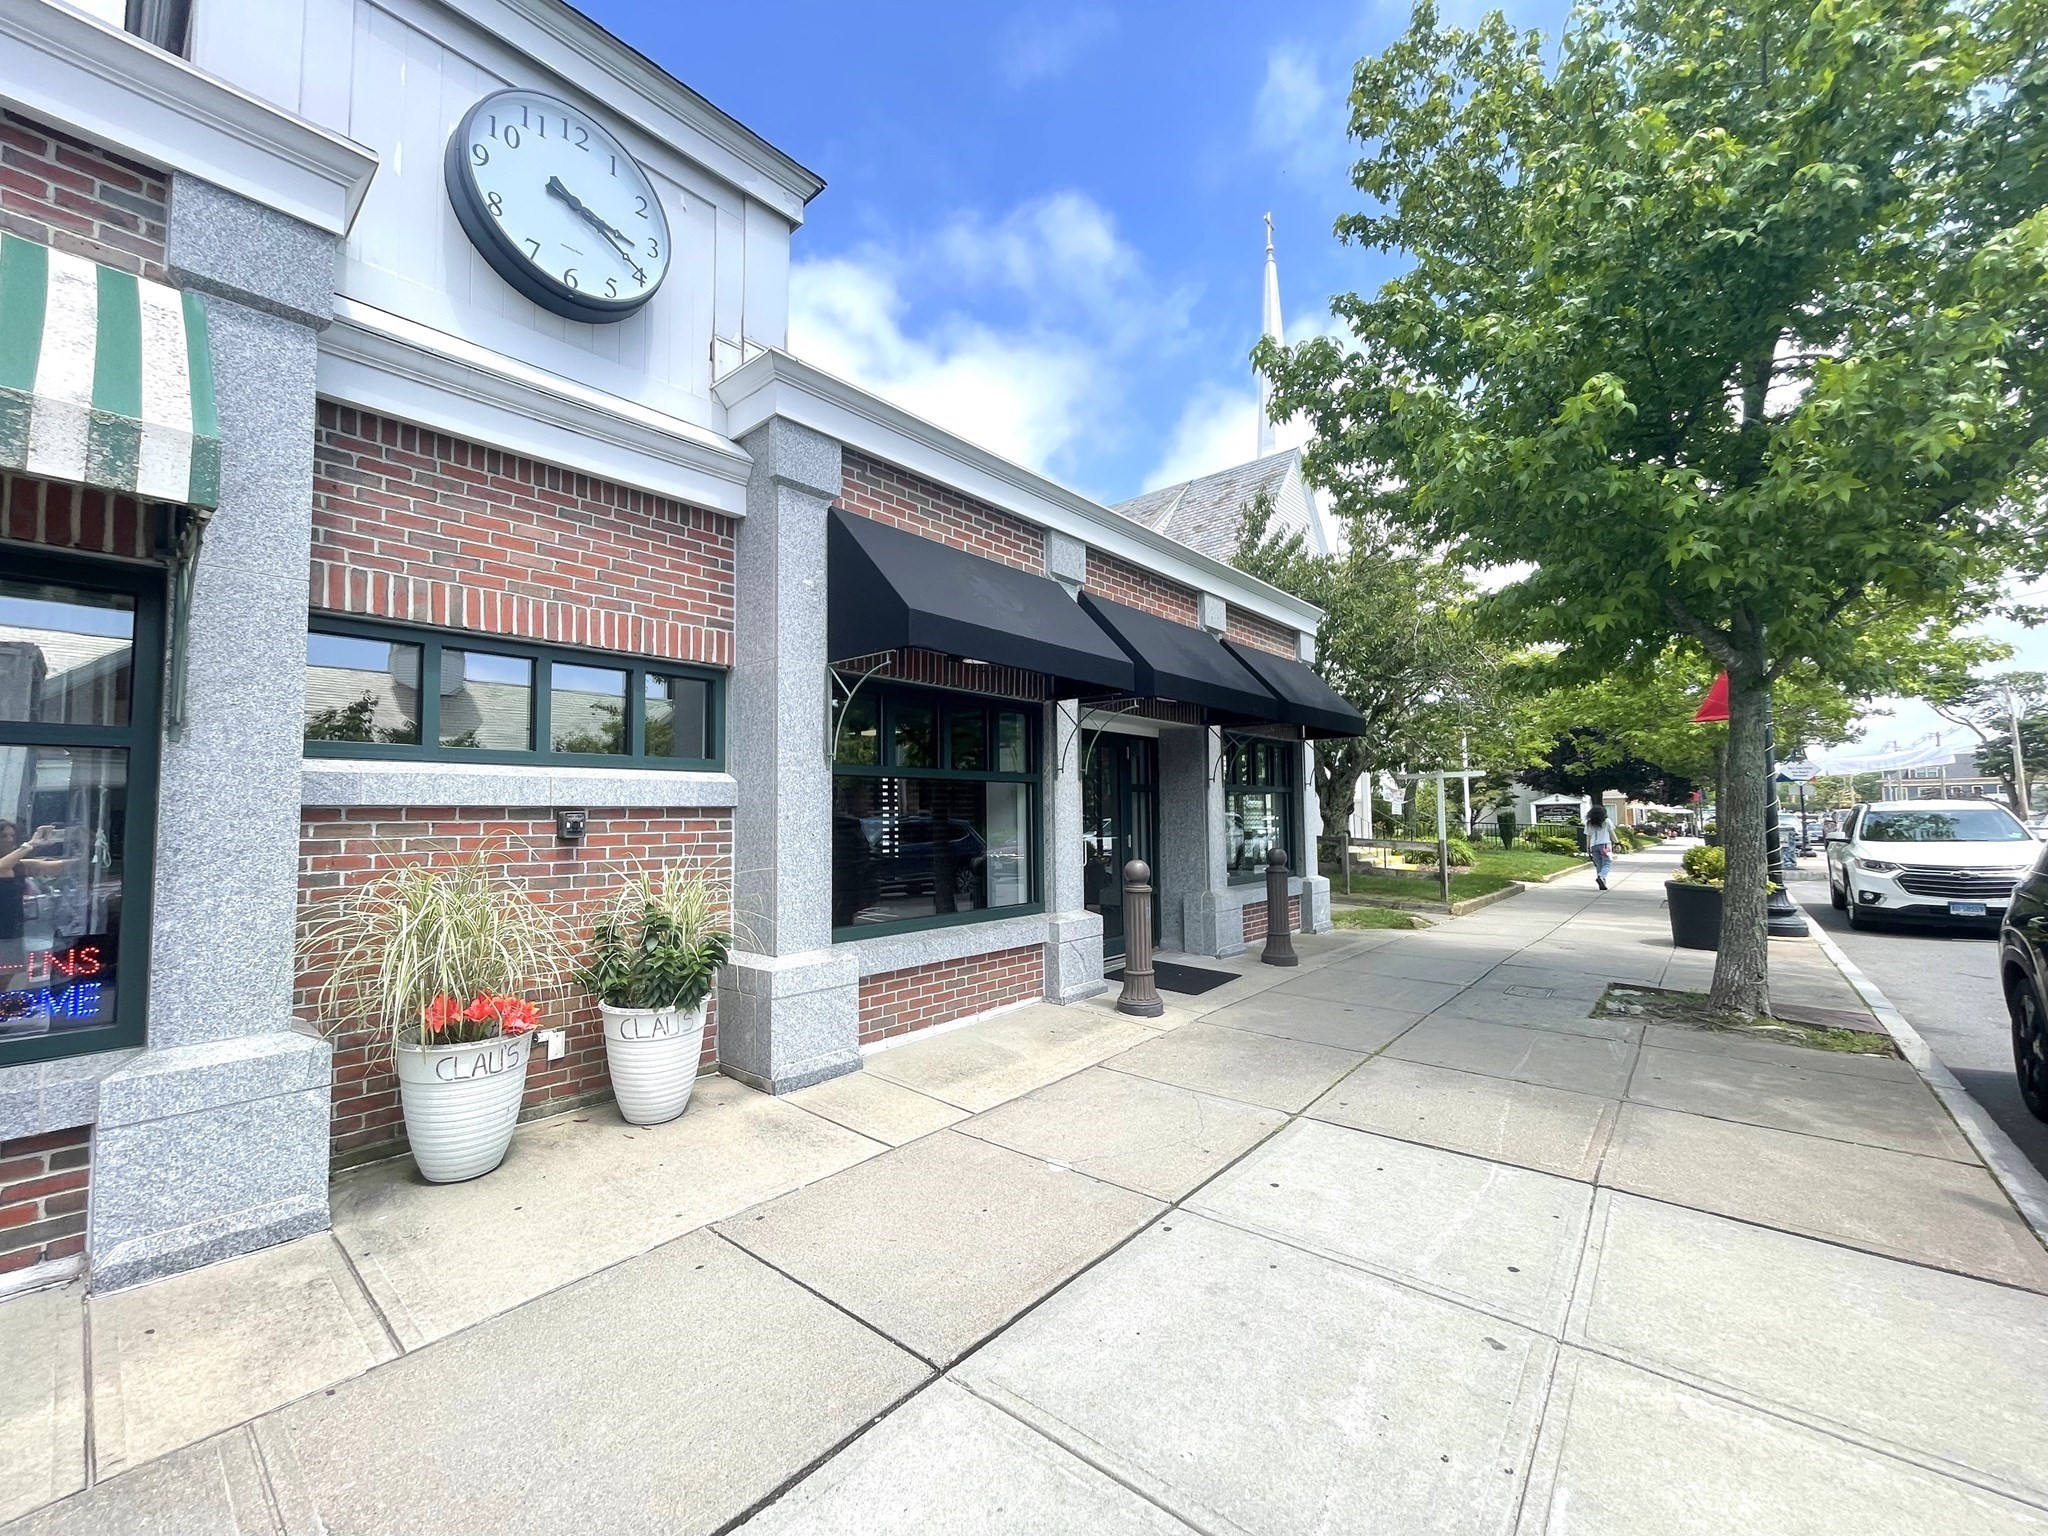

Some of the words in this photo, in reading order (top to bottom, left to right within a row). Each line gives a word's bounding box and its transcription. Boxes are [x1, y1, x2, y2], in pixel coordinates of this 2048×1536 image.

[489, 115, 520, 149] 10
[521, 105, 546, 139] 11
[562, 118, 589, 152] 12
[472, 144, 489, 166] 9
[609, 155, 617, 177] 1
[487, 191, 503, 216] 8
[634, 196, 648, 219] 2
[525, 238, 541, 261] 7
[647, 238, 658, 258] 3
[564, 268, 578, 289] 6
[604, 277, 617, 298] 5
[632, 267, 646, 288] 4
[436, 1041, 520, 1081] CLAU'S
